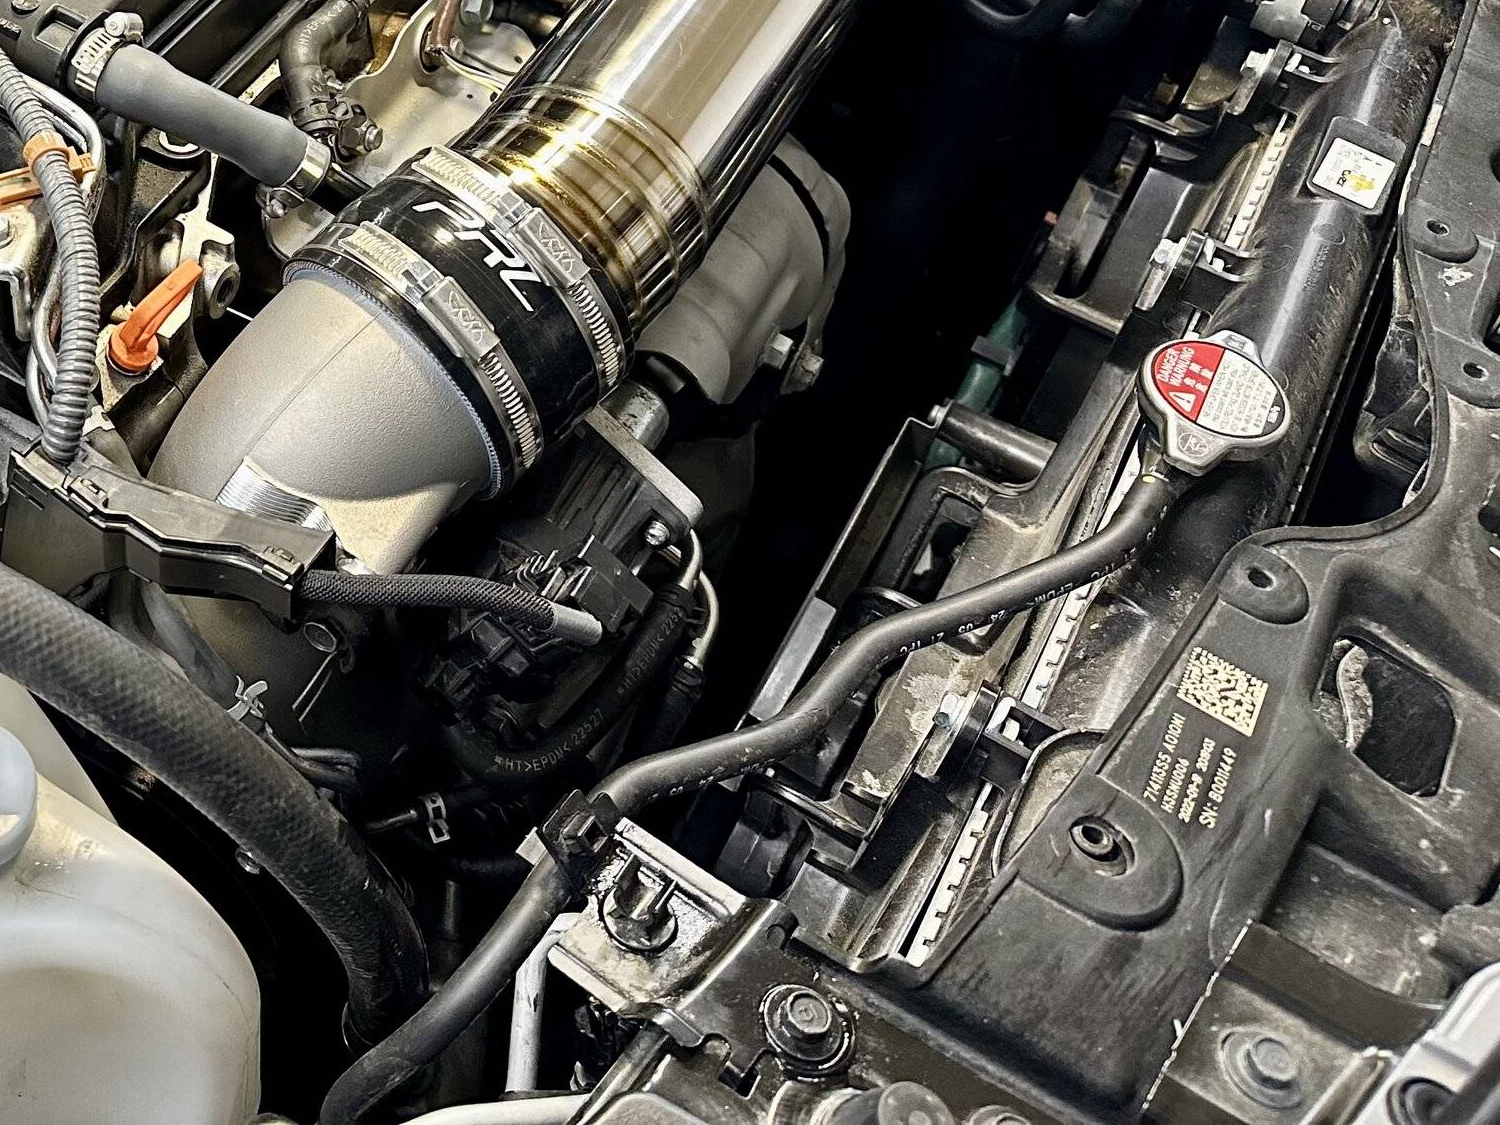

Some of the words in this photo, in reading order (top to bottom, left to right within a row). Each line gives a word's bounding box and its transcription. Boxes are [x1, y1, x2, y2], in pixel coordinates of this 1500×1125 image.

[412, 197, 542, 312] PRL
[1156, 347, 1181, 382] DANGER
[1169, 346, 1196, 387] WARNUNG
[1198, 801, 1218, 829] SN:
